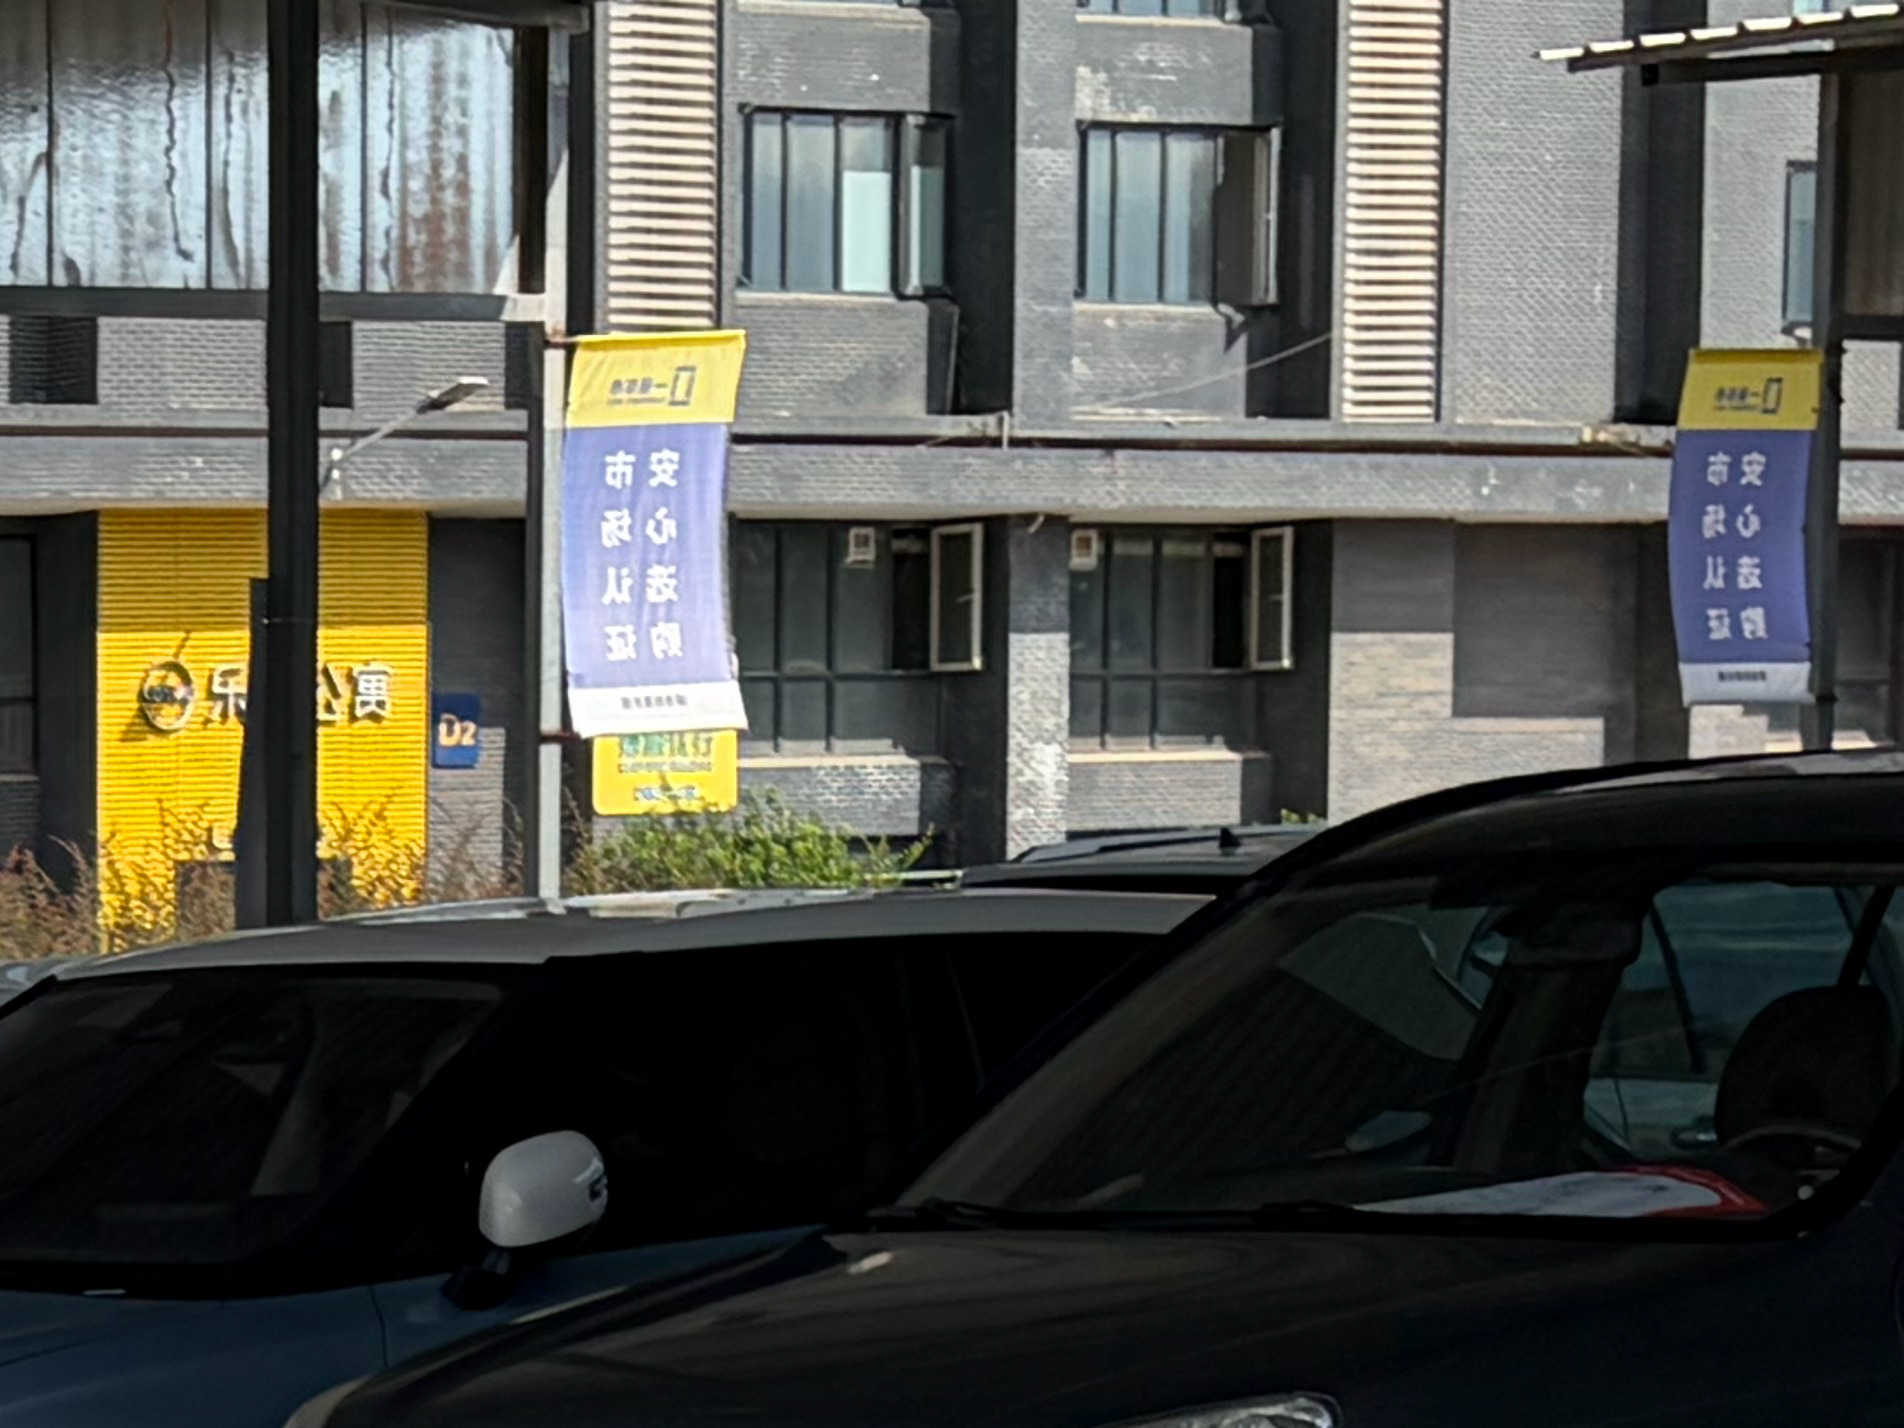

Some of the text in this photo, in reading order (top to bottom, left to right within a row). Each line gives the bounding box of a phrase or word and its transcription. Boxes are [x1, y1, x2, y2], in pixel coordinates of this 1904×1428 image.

[210, 661, 396, 723] 乐公寓
[438, 711, 478, 748] D2
